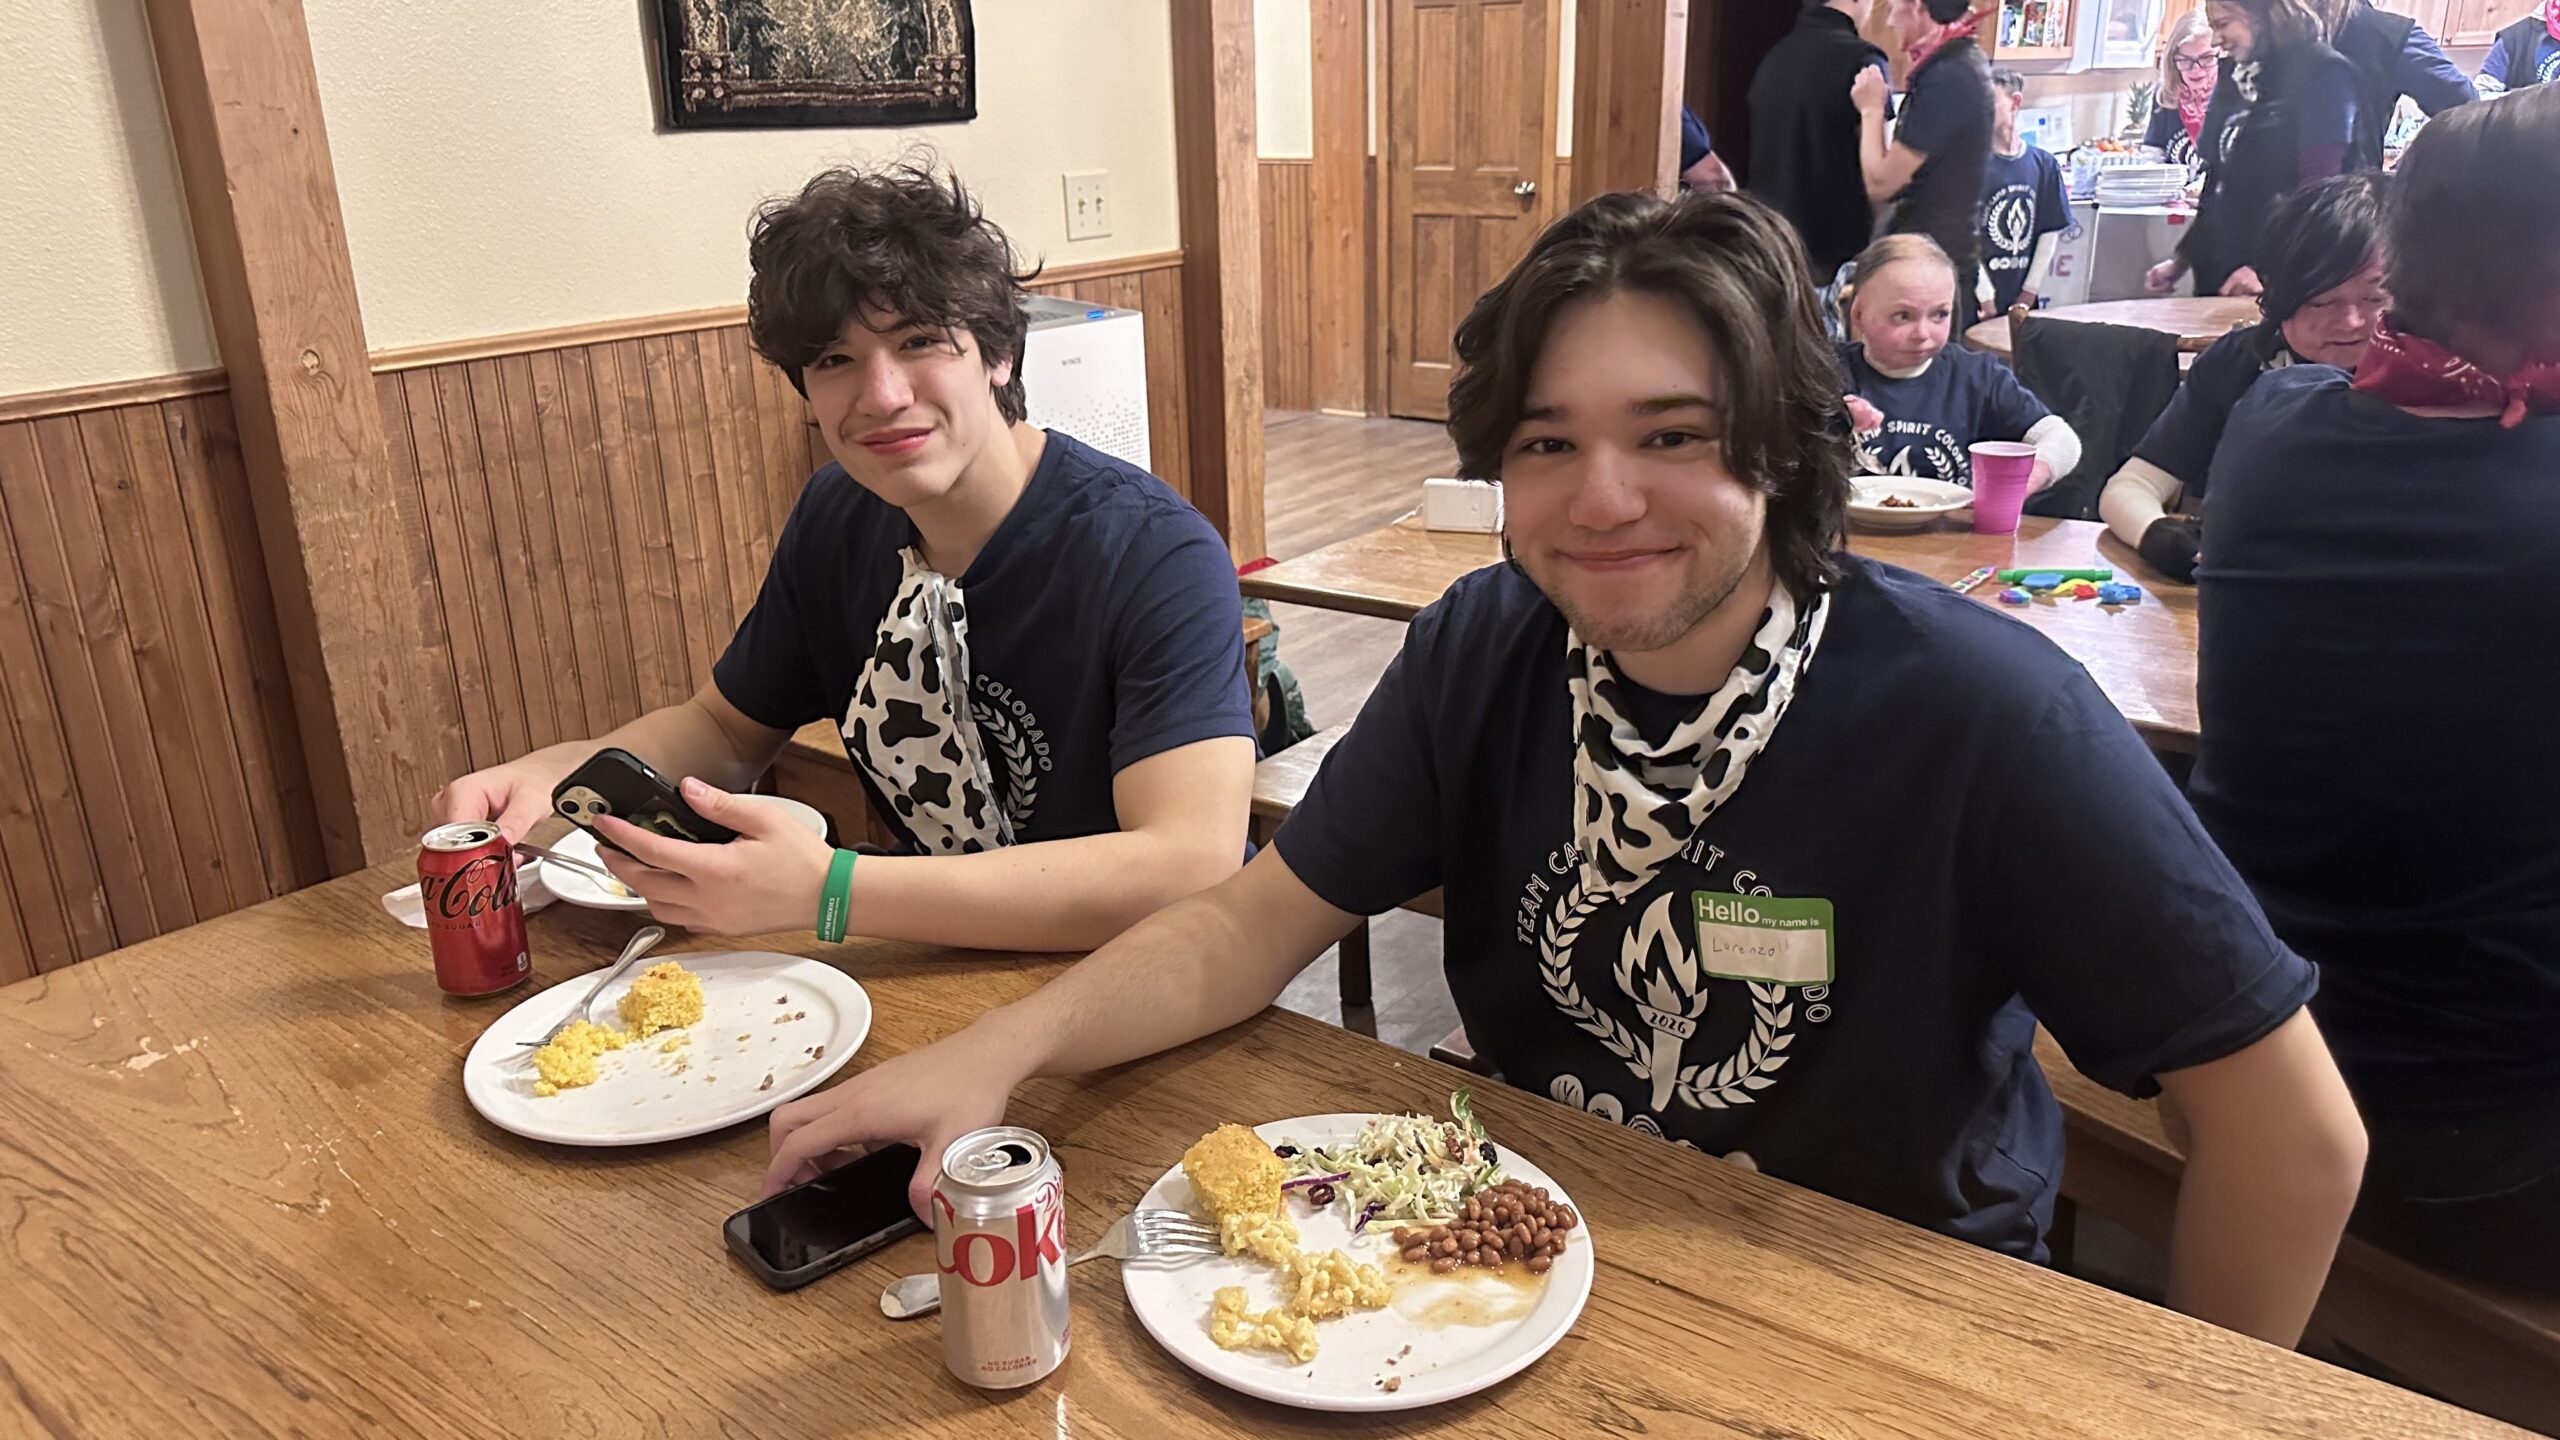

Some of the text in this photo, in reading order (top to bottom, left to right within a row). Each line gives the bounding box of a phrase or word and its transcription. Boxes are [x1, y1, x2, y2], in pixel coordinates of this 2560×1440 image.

[1887, 420, 1932, 436] SPIRIT
[975, 674, 1053, 771] COLORADO
[1698, 897, 1820, 928] Hello my name is
[1517, 839, 1832, 1023] TEAM CA RIT CODO
[1650, 1012, 1686, 1034] 2026
[995, 1359, 1037, 1372] CALORIES
[1002, 1355, 1031, 1367] SUGAR
